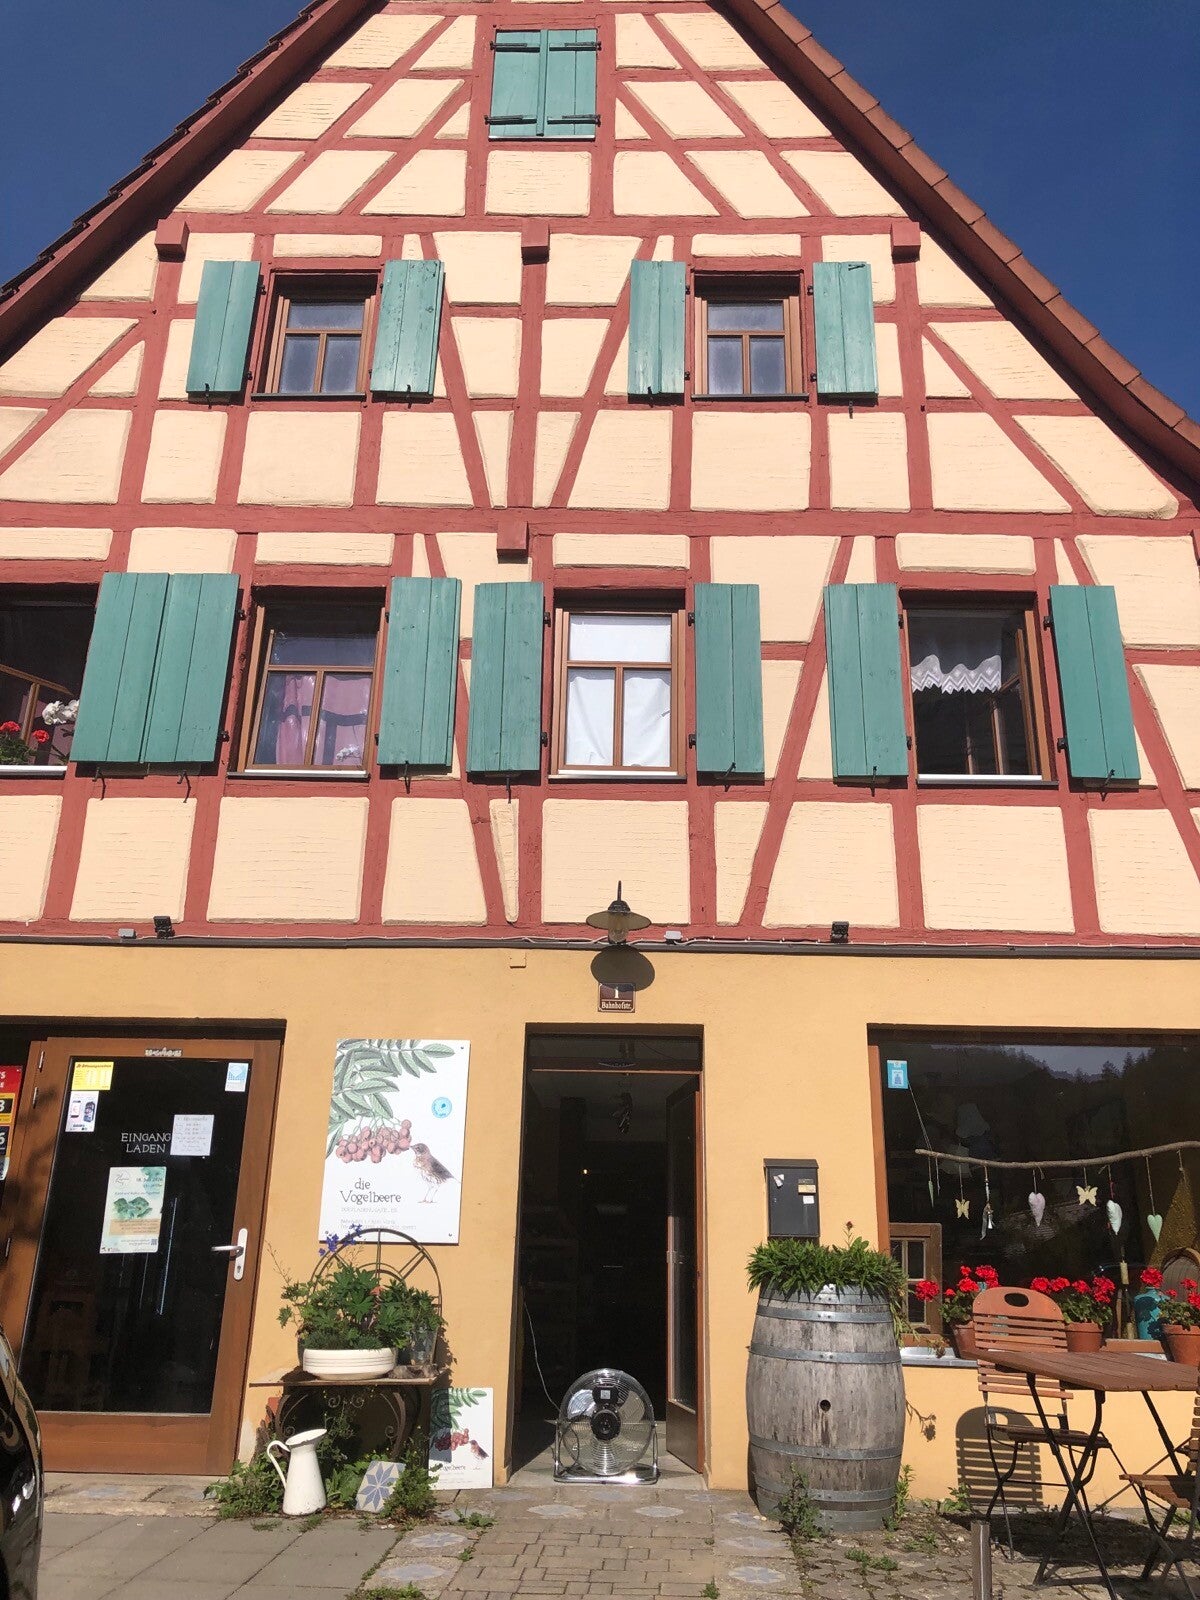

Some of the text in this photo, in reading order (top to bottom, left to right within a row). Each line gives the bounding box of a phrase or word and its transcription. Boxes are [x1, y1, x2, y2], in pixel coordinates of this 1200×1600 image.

[614, 986, 619, 998] 1
[601, 1001, 632, 1010] Bahnhofstr.
[121, 1133, 172, 1142] EINGANG
[126, 1144, 166, 1154] LADEN
[354, 1177, 371, 1189] die
[340, 1190, 402, 1205] Vogelbeere
